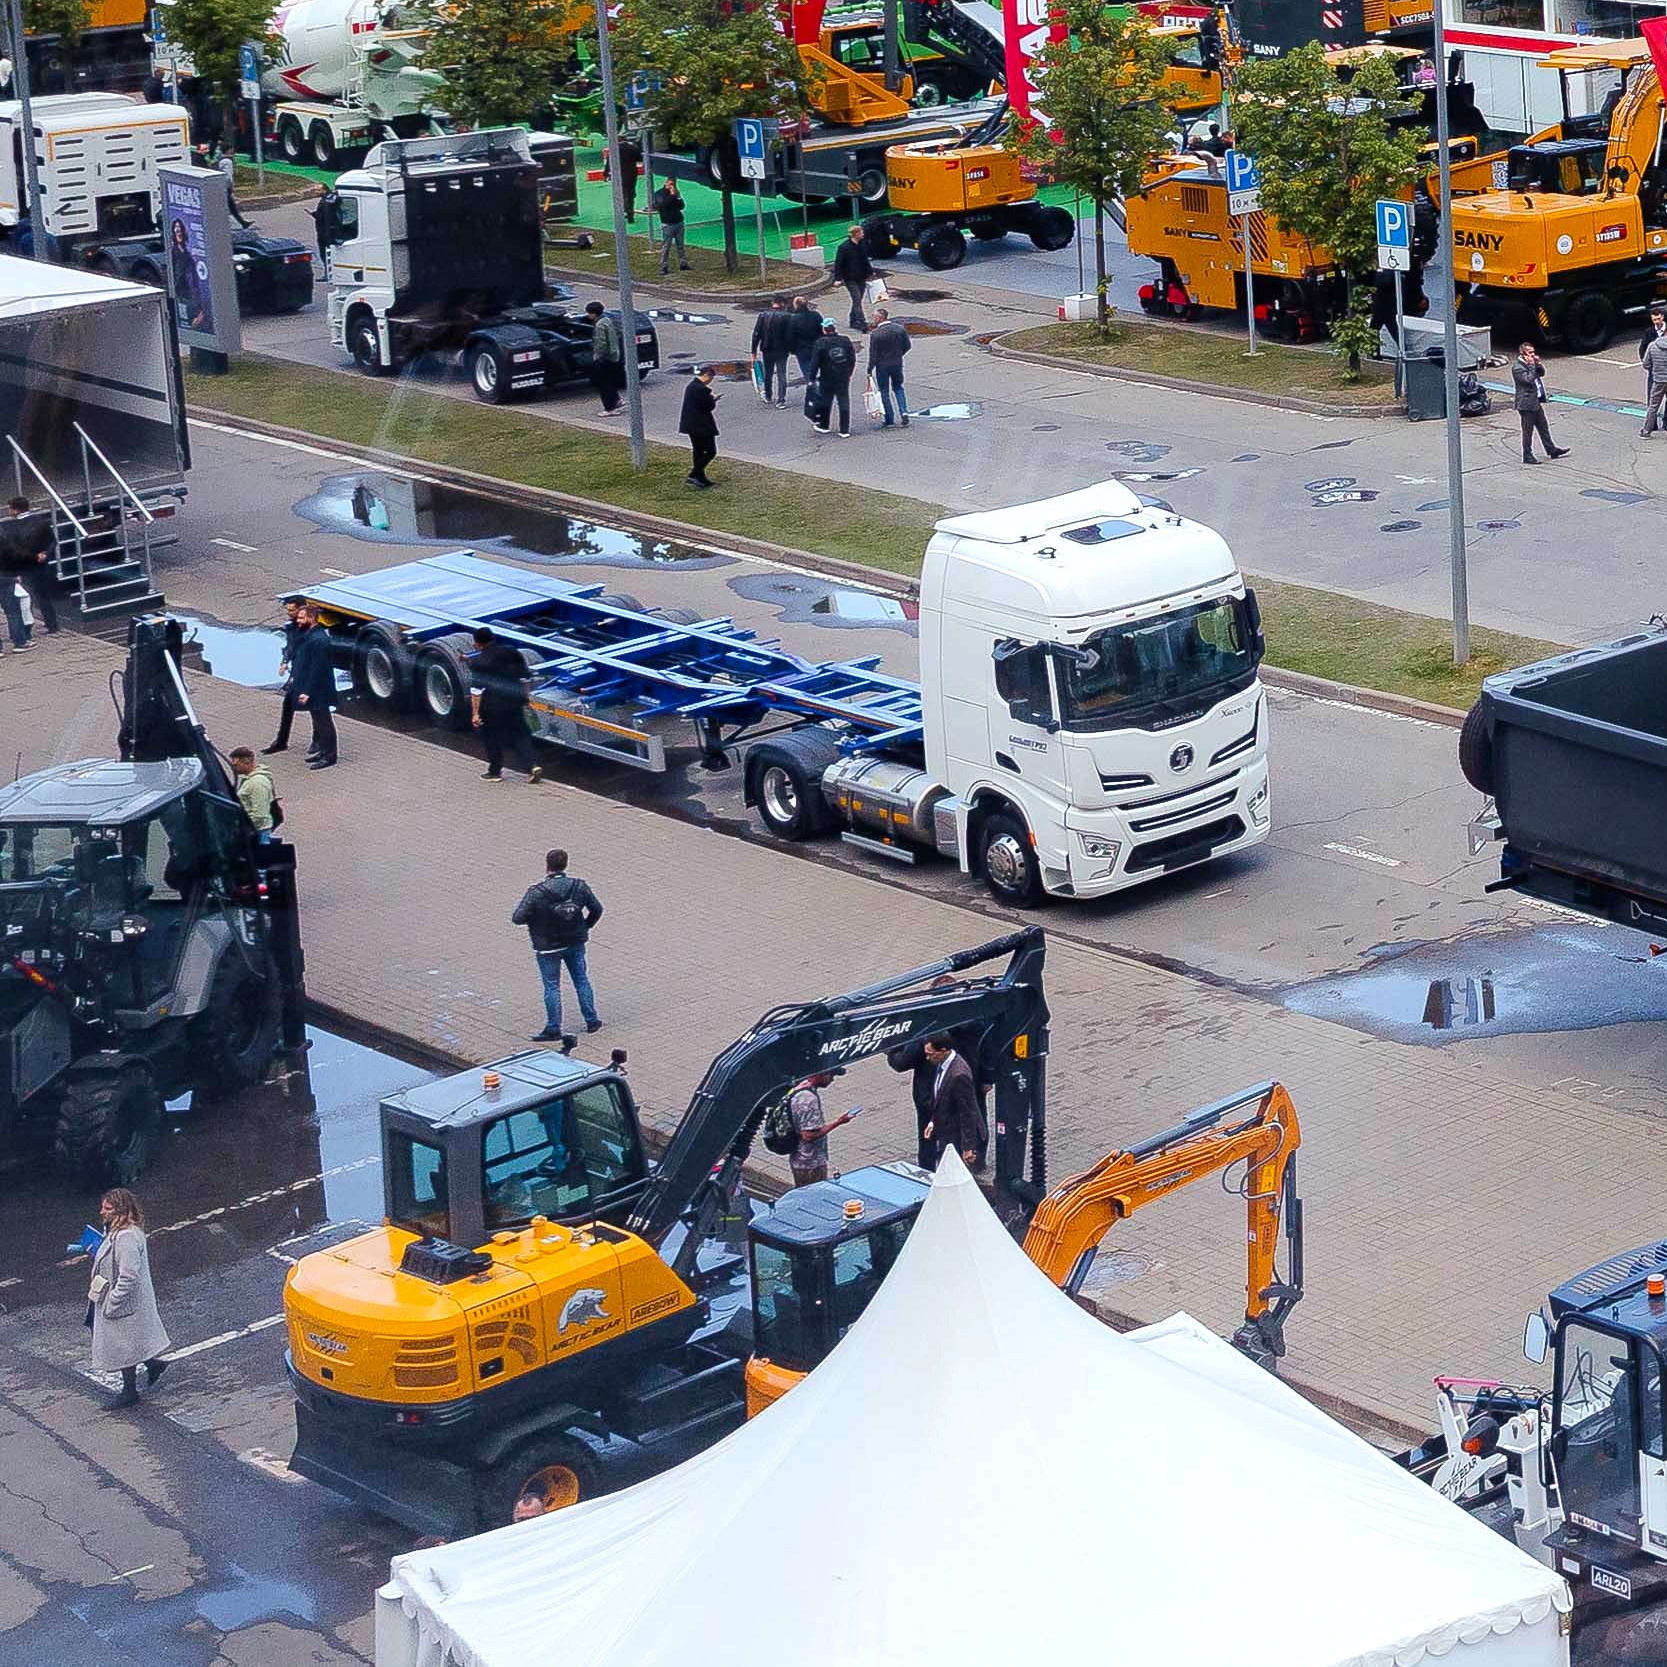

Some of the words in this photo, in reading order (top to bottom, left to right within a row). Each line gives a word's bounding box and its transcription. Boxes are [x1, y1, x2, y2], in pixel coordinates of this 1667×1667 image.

[1253, 44, 1281, 56] SANY
[743, 123, 758, 154] P
[1232, 153, 1251, 187] P
[167, 184, 201, 207] VEGAS
[1231, 198, 1241, 210] 10
[1163, 226, 1188, 239] SANY
[1383, 206, 1400, 240] P
[1454, 230, 1504, 251] SANY
[819, 1031, 869, 1056] ARCTIC
[872, 1020, 913, 1043] BEAR
[552, 1329, 591, 1352] ARCTIC
[591, 1319, 622, 1339] BEAR
[1594, 1571, 1628, 1595] ARL20
